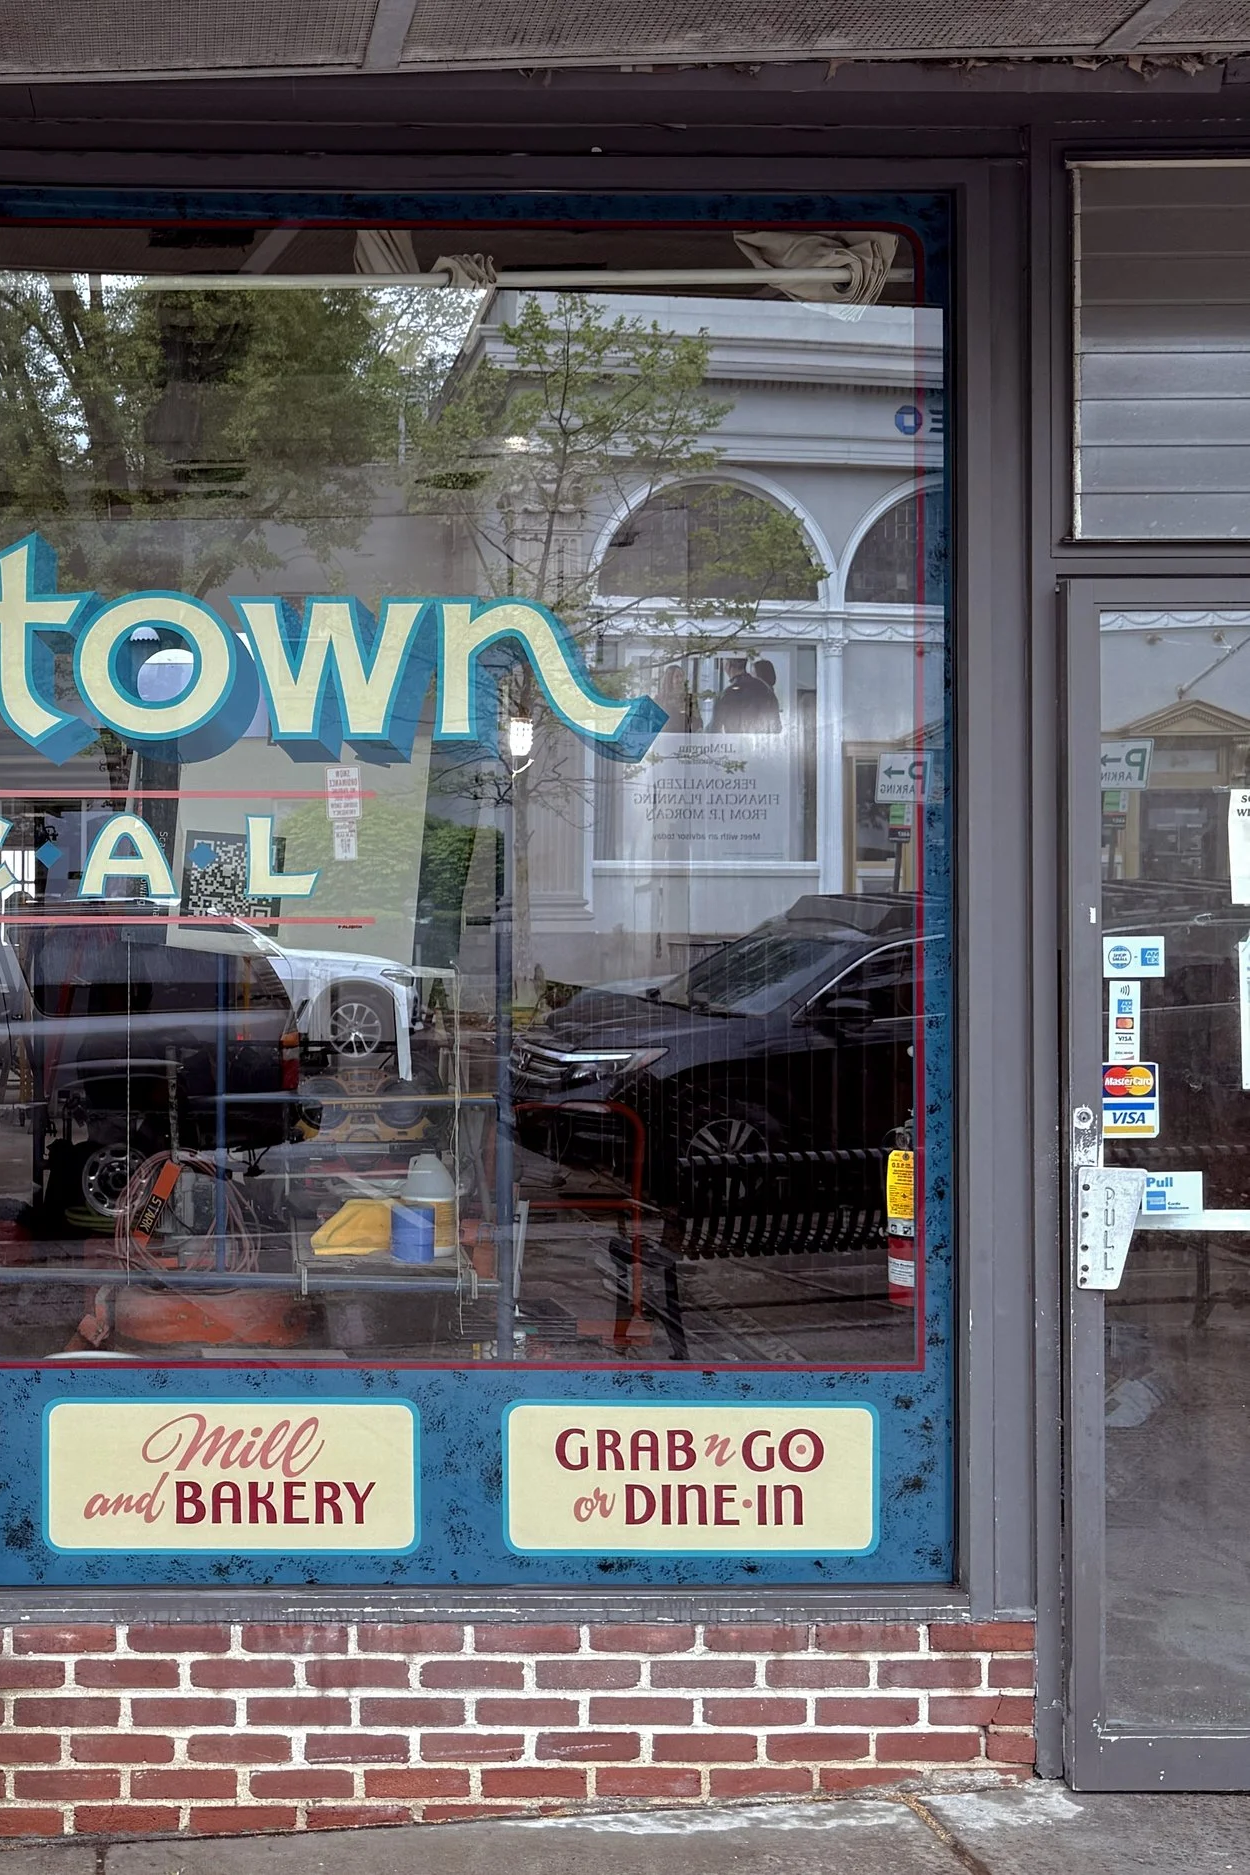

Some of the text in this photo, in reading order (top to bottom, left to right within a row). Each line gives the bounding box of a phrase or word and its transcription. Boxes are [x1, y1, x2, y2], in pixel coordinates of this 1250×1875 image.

[1104, 1076, 1152, 1087] MasterCard
[1112, 1112, 1146, 1124] VISA
[1146, 1177, 1173, 1187] Pull
[139, 1195, 163, 1234] STARK
[1104, 1187, 1116, 1271] PULL
[141, 1413, 326, 1478] Mill
[554, 1428, 826, 1473] GRAB n GO
[83, 1471, 377, 1525] and BAKERY
[572, 1487, 617, 1524] or
